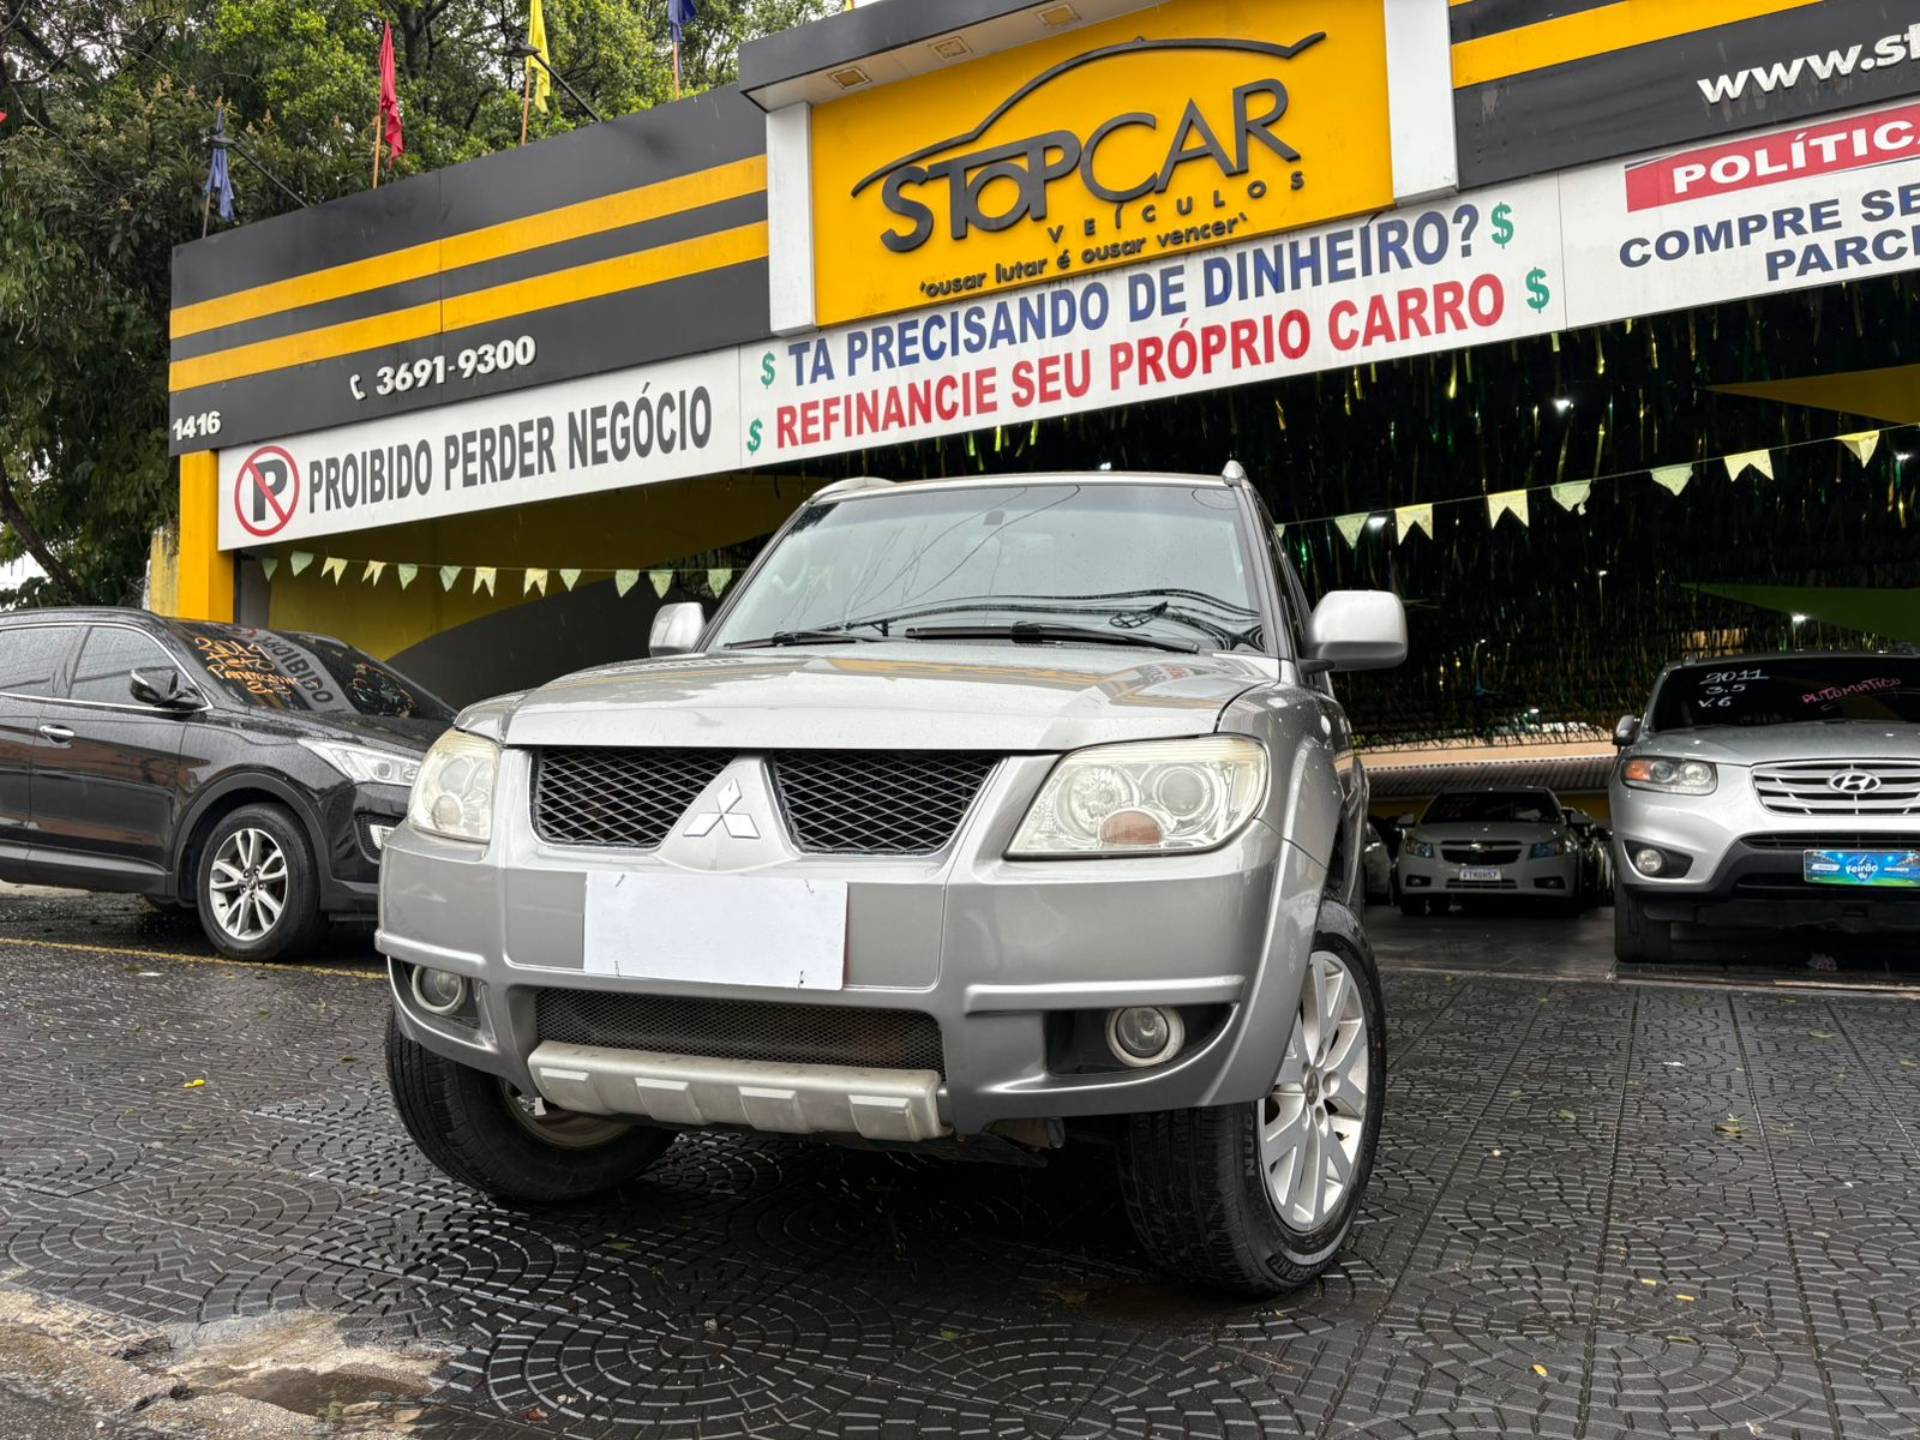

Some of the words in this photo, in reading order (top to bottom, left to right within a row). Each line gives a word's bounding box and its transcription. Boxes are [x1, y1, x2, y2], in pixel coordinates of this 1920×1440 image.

[1674, 119, 1920, 193] POLÍTIC
[995, 258, 1048, 284] lutar
[1057, 249, 1071, 270] é
[1082, 237, 1147, 264] ousar
[1620, 199, 1842, 268] COMPRE
[788, 335, 835, 386] TA
[847, 282, 1109, 377] PRECISANDO
[1128, 265, 1187, 323] DE
[376, 335, 537, 396] 3691-9300
[777, 367, 998, 449] REFINANCIE
[1012, 350, 1091, 408] SEU
[1110, 309, 1311, 391] PRÓPRIO
[1328, 275, 1505, 352] CARRO
[172, 411, 222, 441] 1416
[309, 440, 432, 514] PROIBIDO
[444, 417, 556, 491] PERDER
[568, 382, 712, 470] NEGÓCIO
